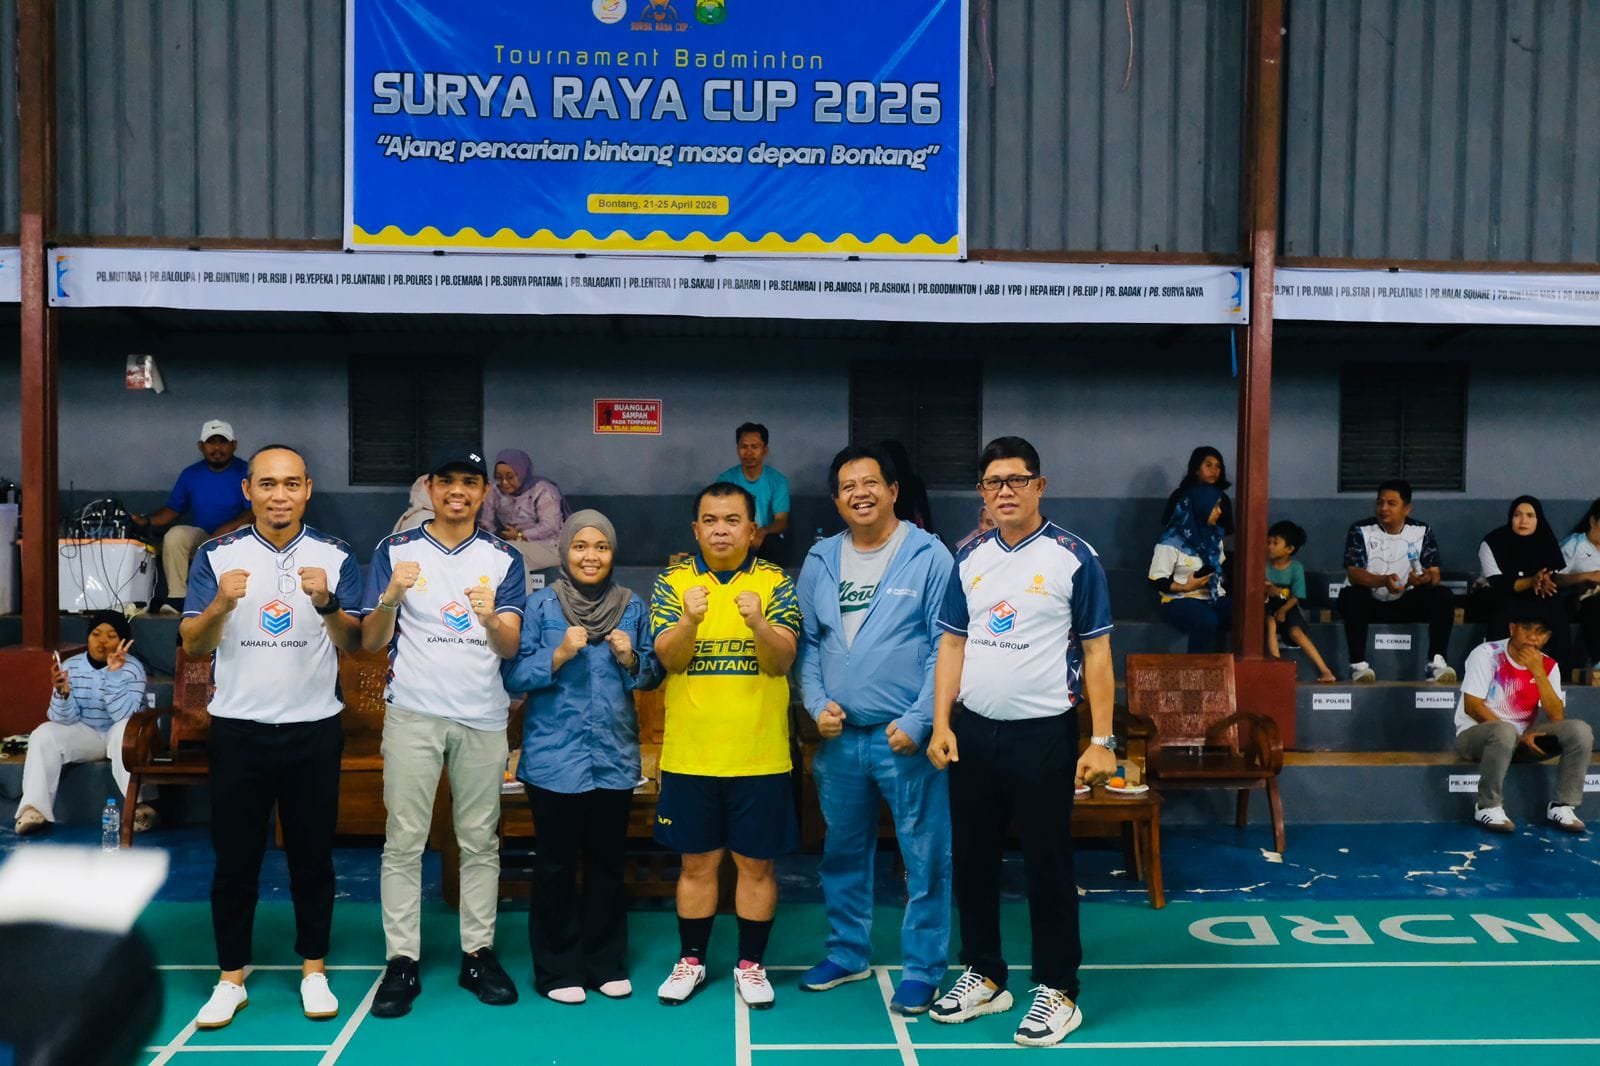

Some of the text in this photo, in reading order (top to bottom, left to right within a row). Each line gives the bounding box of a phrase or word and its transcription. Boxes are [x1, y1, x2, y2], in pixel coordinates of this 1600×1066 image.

[494, 45, 823, 70] Tournament Badminton
[373, 72, 941, 124] SURYA RAYA CUP 2026
[459, 139, 579, 163] pencarian
[583, 140, 674, 167] bintang
[678, 144, 743, 163] masa
[747, 142, 825, 168] depan
[598, 199, 718, 210] Bontang, 21-25 April 2026
[204, 271, 250, 283] PB.GUNTUNG
[295, 273, 333, 284] PB.YEPEKA
[341, 274, 385, 285] PB.LANTANG
[393, 274, 433, 286] PB.POLRES
[441, 275, 483, 286] PB.CEMARA
[629, 277, 671, 289] PB.LENTERA
[824, 281, 862, 293] PB.AMOSA
[870, 282, 910, 294] PB.ASHOKA
[918, 283, 977, 295] PB.GOODMINTON
[984, 284, 1000, 295] J&B
[1162, 286, 1185, 298] SURYA
[1186, 286, 1204, 298] RAYA
[1274, 285, 1295, 297] B.PKT
[1302, 286, 1334, 297] PB.PAMA
[281, 640, 308, 648] GROUP
[427, 636, 463, 644] KAHARLA
[1000, 641, 1030, 650] GROUP
